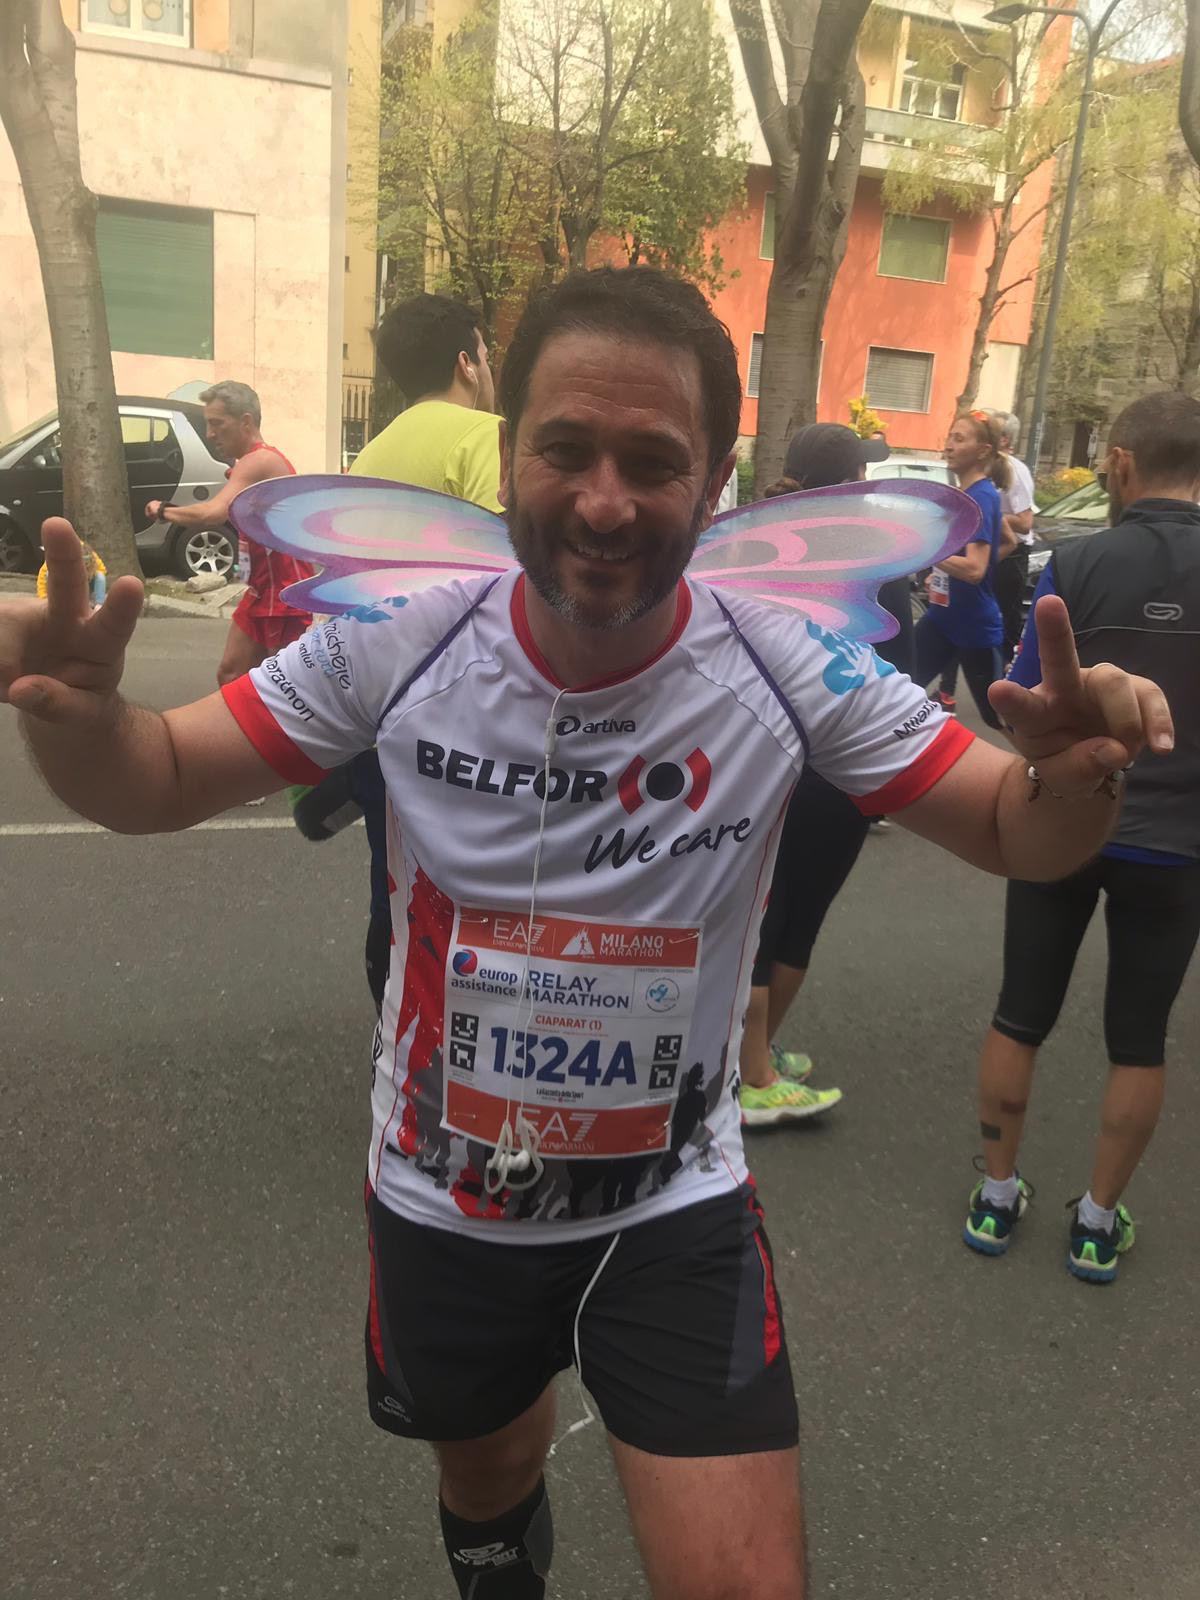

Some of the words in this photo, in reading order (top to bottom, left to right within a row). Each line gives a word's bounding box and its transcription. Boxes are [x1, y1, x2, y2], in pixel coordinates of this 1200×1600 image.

[582, 717, 637, 735] artiva
[416, 739, 608, 803] BELFOR
[584, 825, 662, 874] We
[670, 817, 752, 858] care
[493, 918, 547, 945] EA7
[600, 932, 664, 949] MILANO
[599, 946, 664, 958] MARATHON
[451, 978, 517, 997] assistance
[479, 968, 518, 985] europ
[527, 970, 598, 992] RELAY
[526, 987, 630, 1009] MARATHON
[535, 1014, 587, 1029] CIAPARAT
[588, 1019, 603, 1031] (1)
[490, 1026, 637, 1087] 1324A
[515, 1106, 598, 1142] EA7
